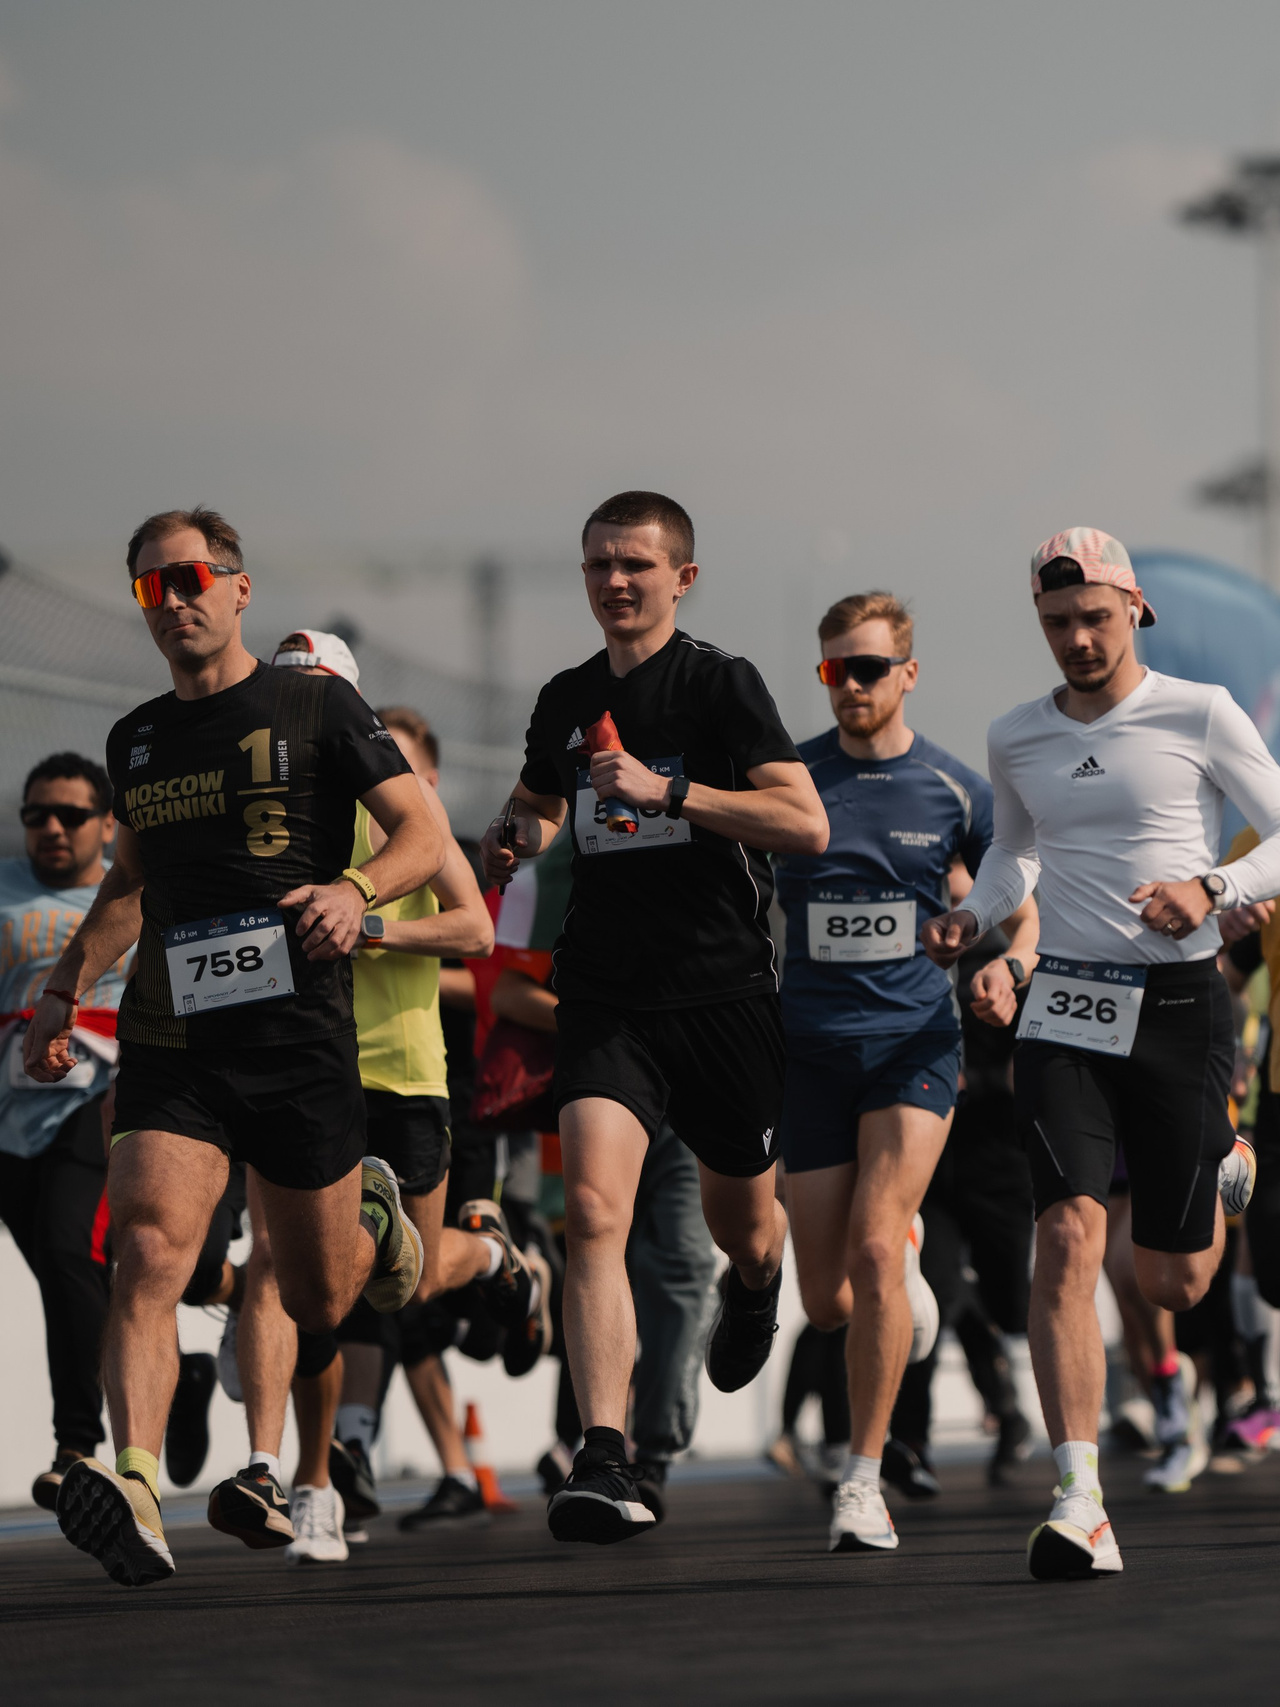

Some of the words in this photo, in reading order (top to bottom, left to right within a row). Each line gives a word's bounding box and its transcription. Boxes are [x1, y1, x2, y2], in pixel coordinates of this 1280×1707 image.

[131, 744, 148, 757] IRON
[238, 728, 271, 782] 1
[278, 740, 289, 780] FINISHER
[129, 753, 150, 770] STAR
[1072, 766, 1105, 779] adidas
[125, 770, 224, 812] MOSCOW
[243, 800, 290, 857] 8
[240, 916, 256, 928] 4,6
[826, 915, 897, 938] 820
[174, 930, 186, 941] 4,6
[187, 946, 264, 983] 758
[1045, 960, 1059, 970] 4,6
[1104, 969, 1119, 980] 4,6
[1046, 990, 1118, 1024] 326
